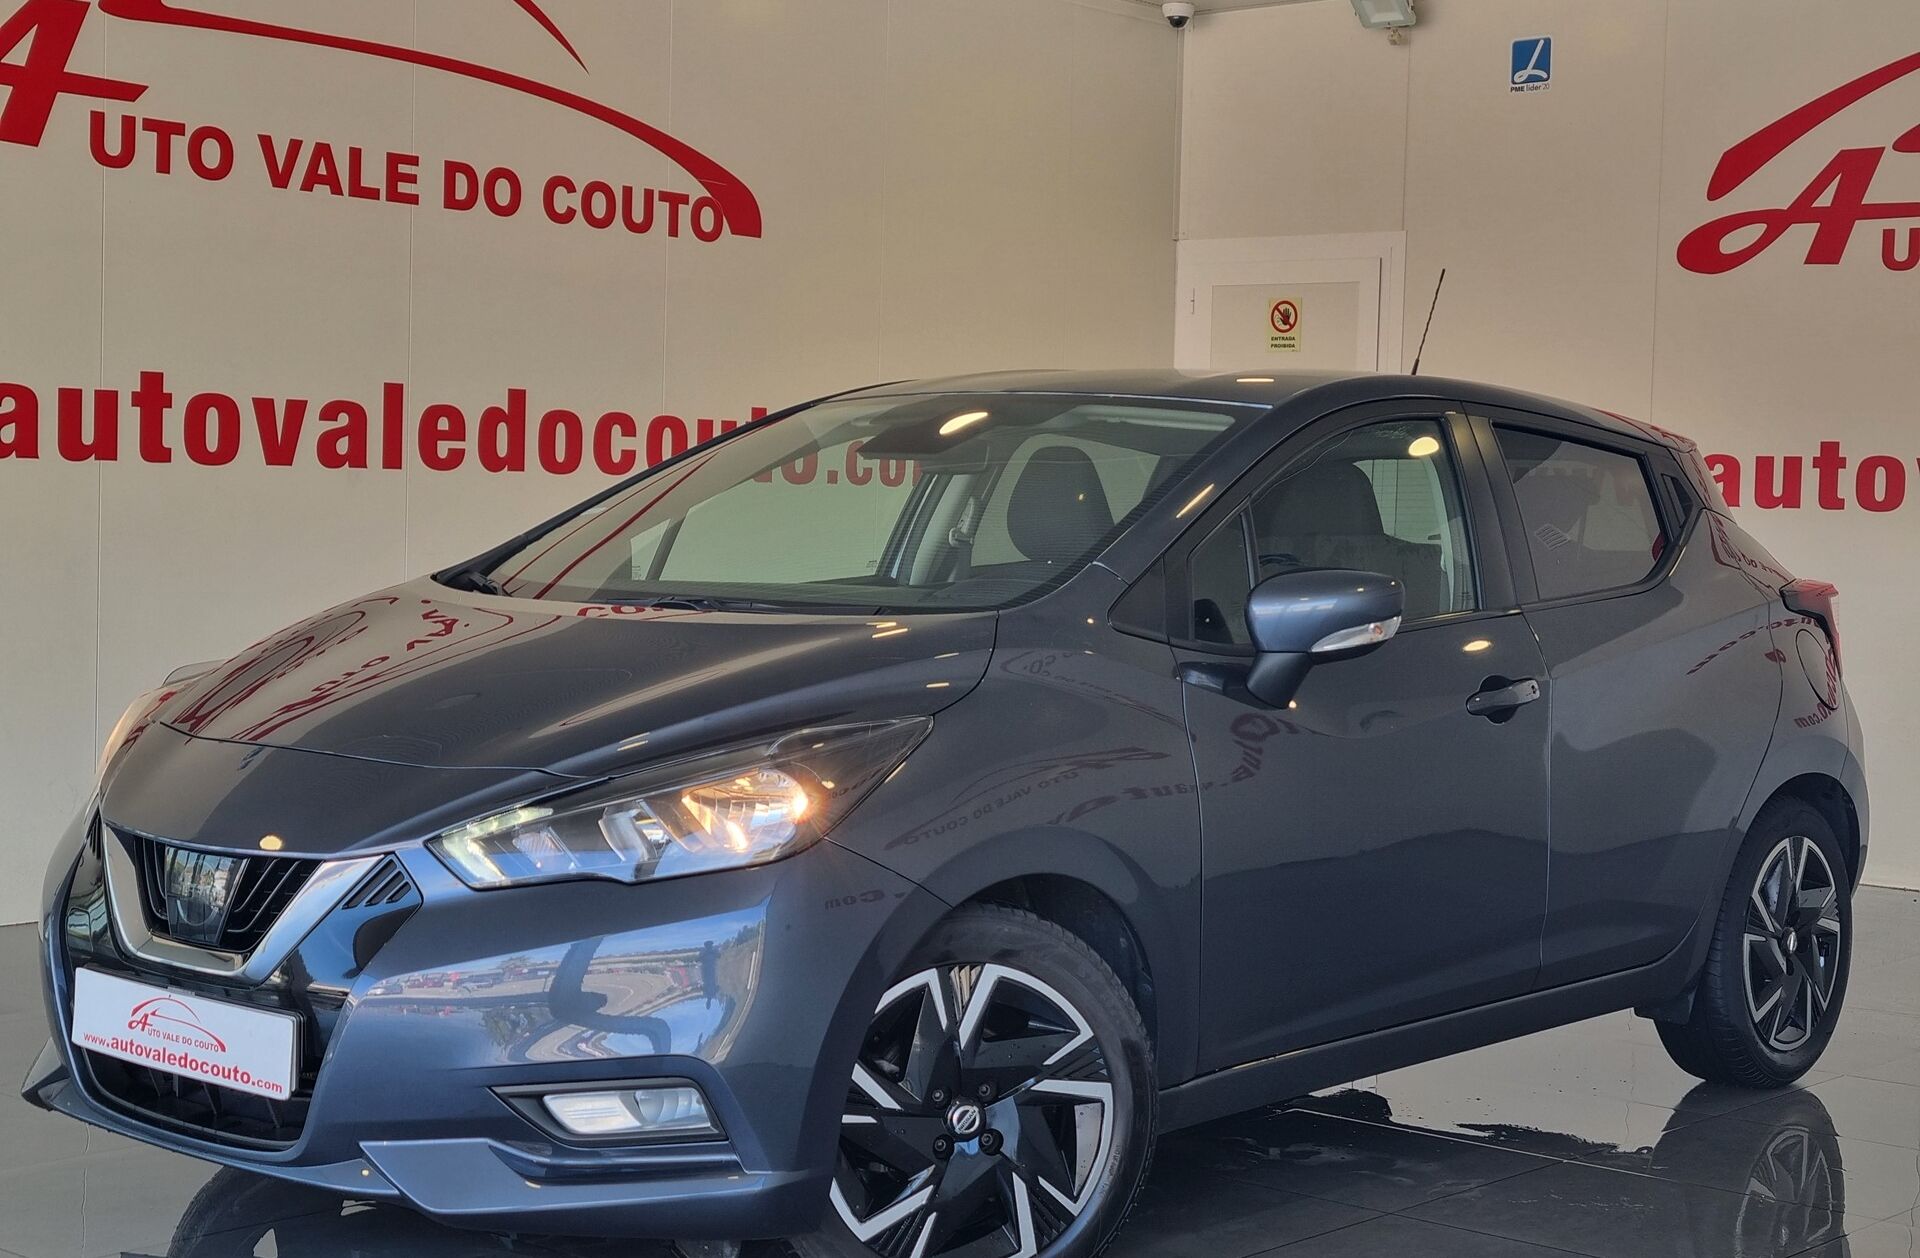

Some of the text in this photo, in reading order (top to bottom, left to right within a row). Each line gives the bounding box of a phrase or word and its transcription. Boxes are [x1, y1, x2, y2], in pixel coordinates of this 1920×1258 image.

[257, 134, 420, 206] VALE
[443, 160, 522, 218] DO
[542, 175, 724, 242] COUTO
[1704, 441, 1920, 513] auto
[83, 1032, 283, 1094] www.autovaledocouto.com
[162, 1031, 180, 1044] VALE
[181, 1036, 193, 1046] DO
[194, 1039, 219, 1053] COUTO
